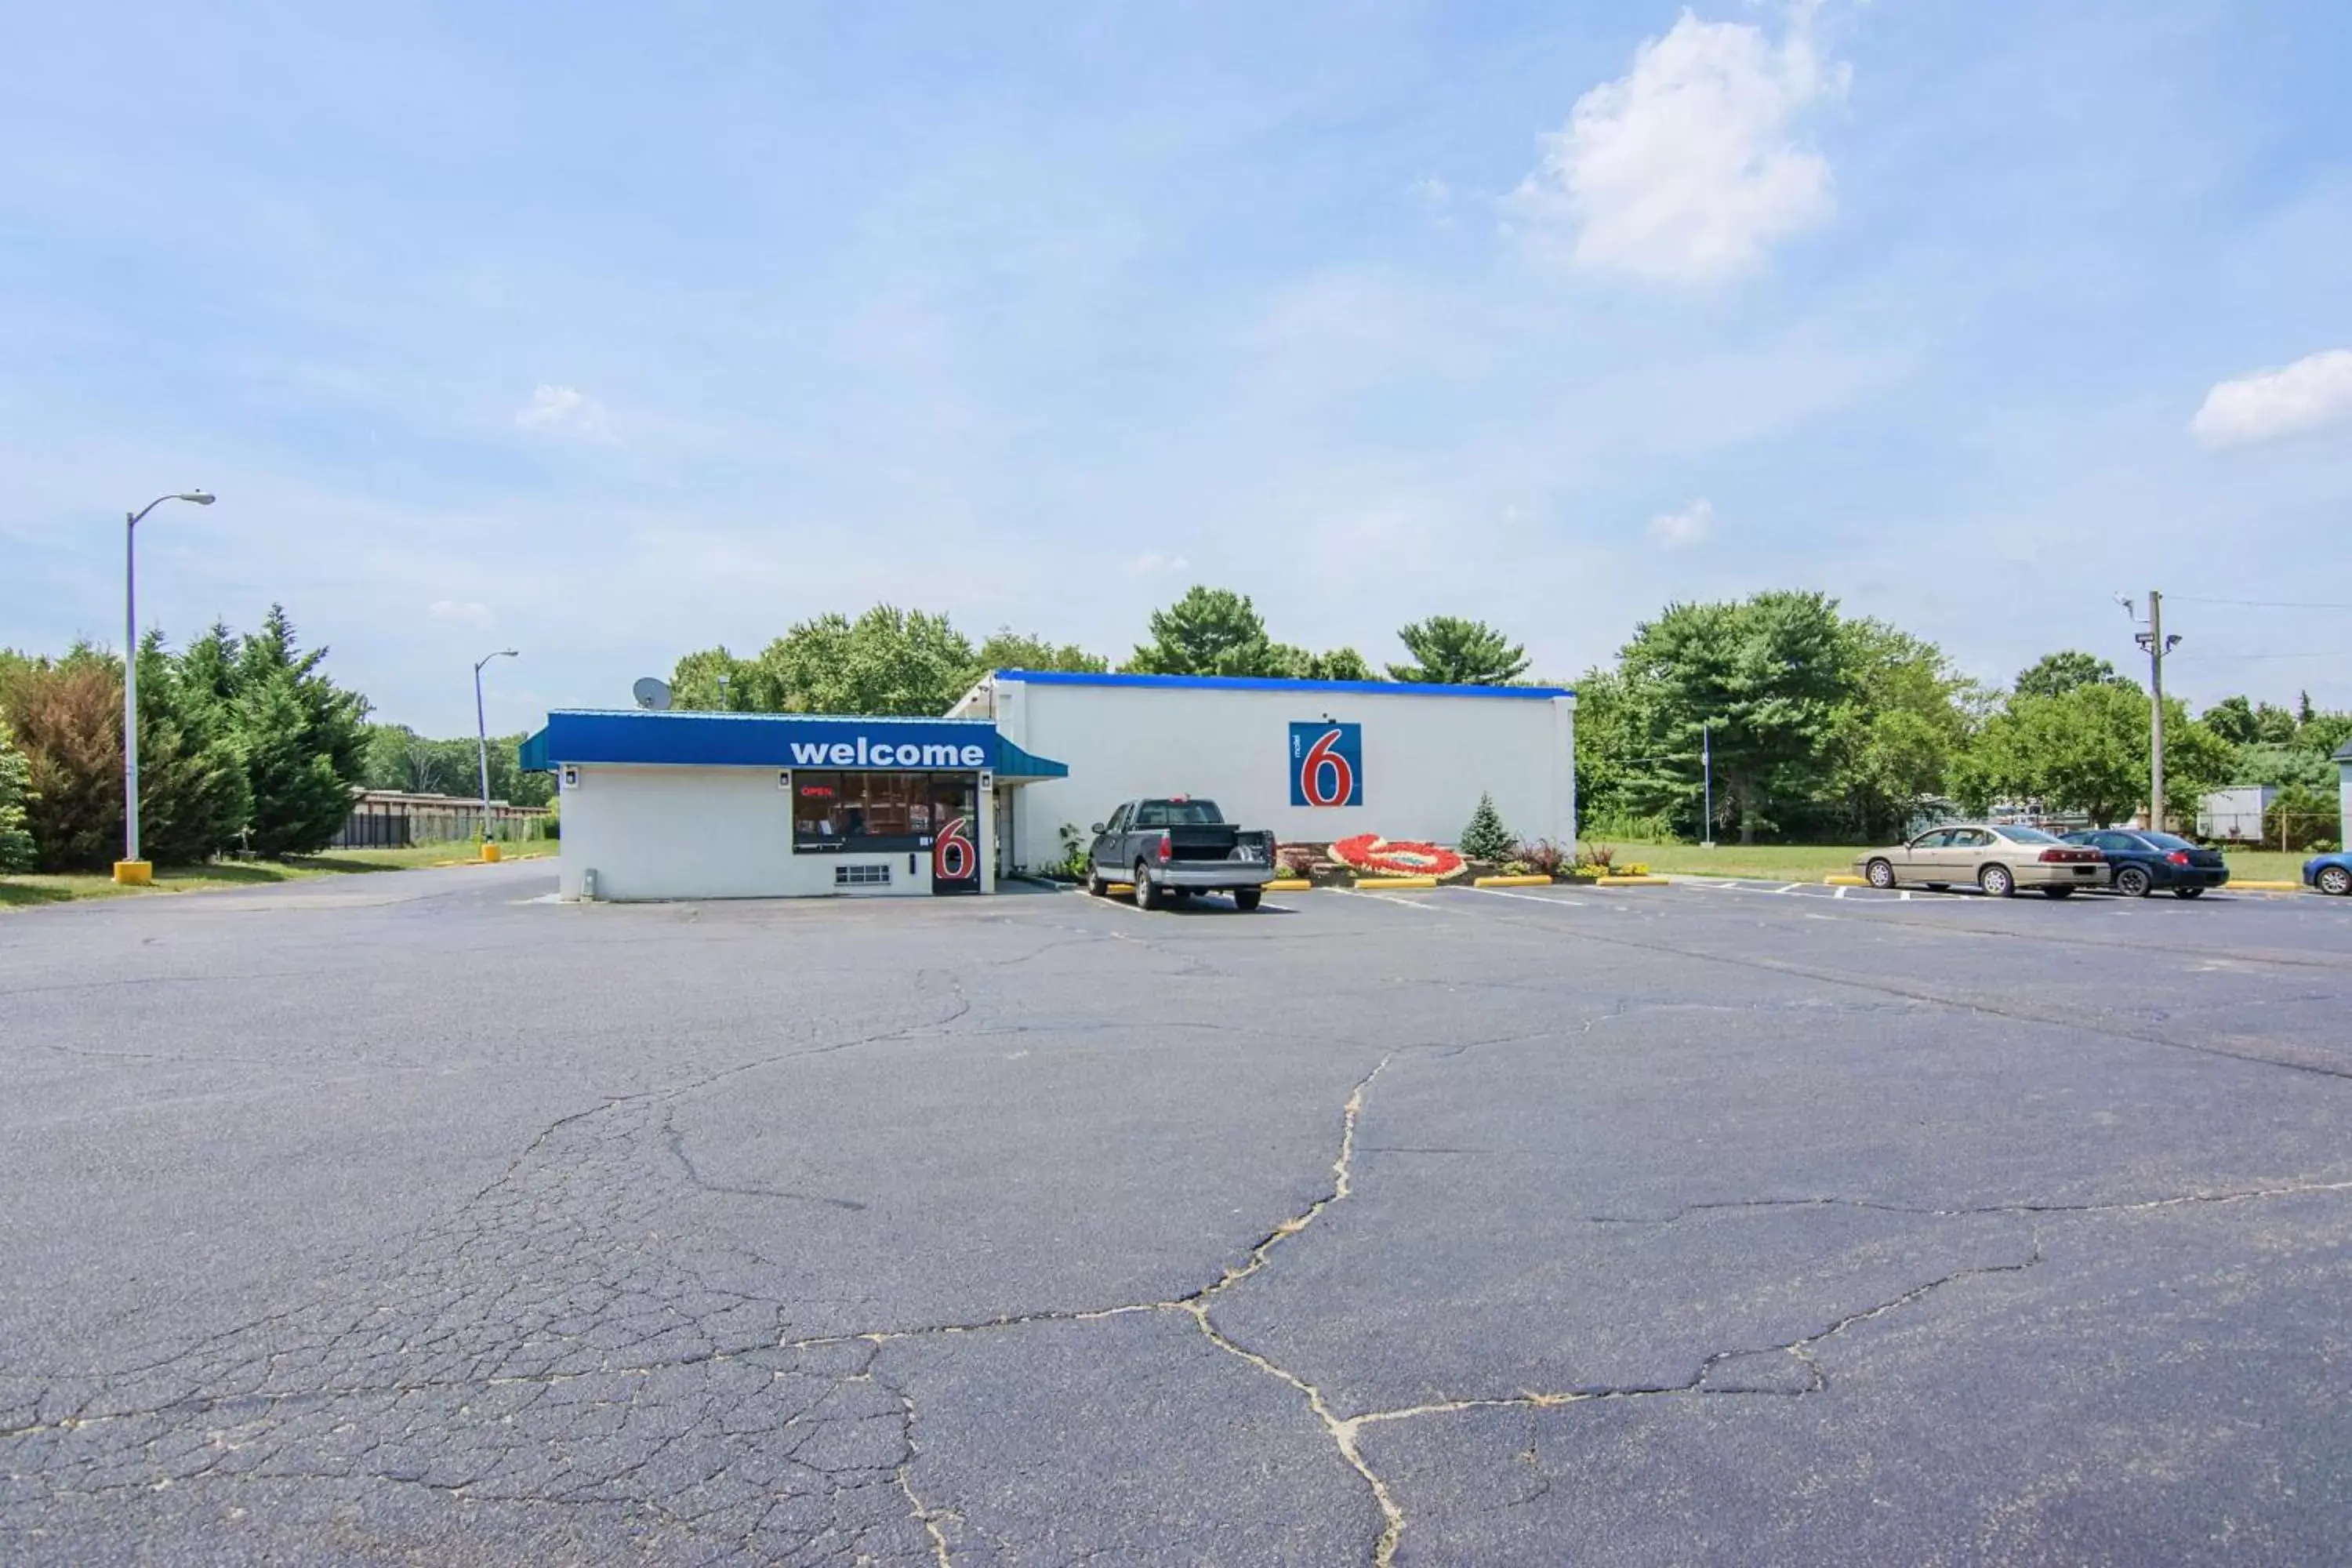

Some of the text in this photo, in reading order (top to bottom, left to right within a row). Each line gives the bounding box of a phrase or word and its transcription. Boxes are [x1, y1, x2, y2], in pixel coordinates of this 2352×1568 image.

[790, 737, 985, 766] welcome
[1301, 728, 1353, 808] 6
[802, 787, 833, 797] OPEN
[935, 818, 975, 879] 6
